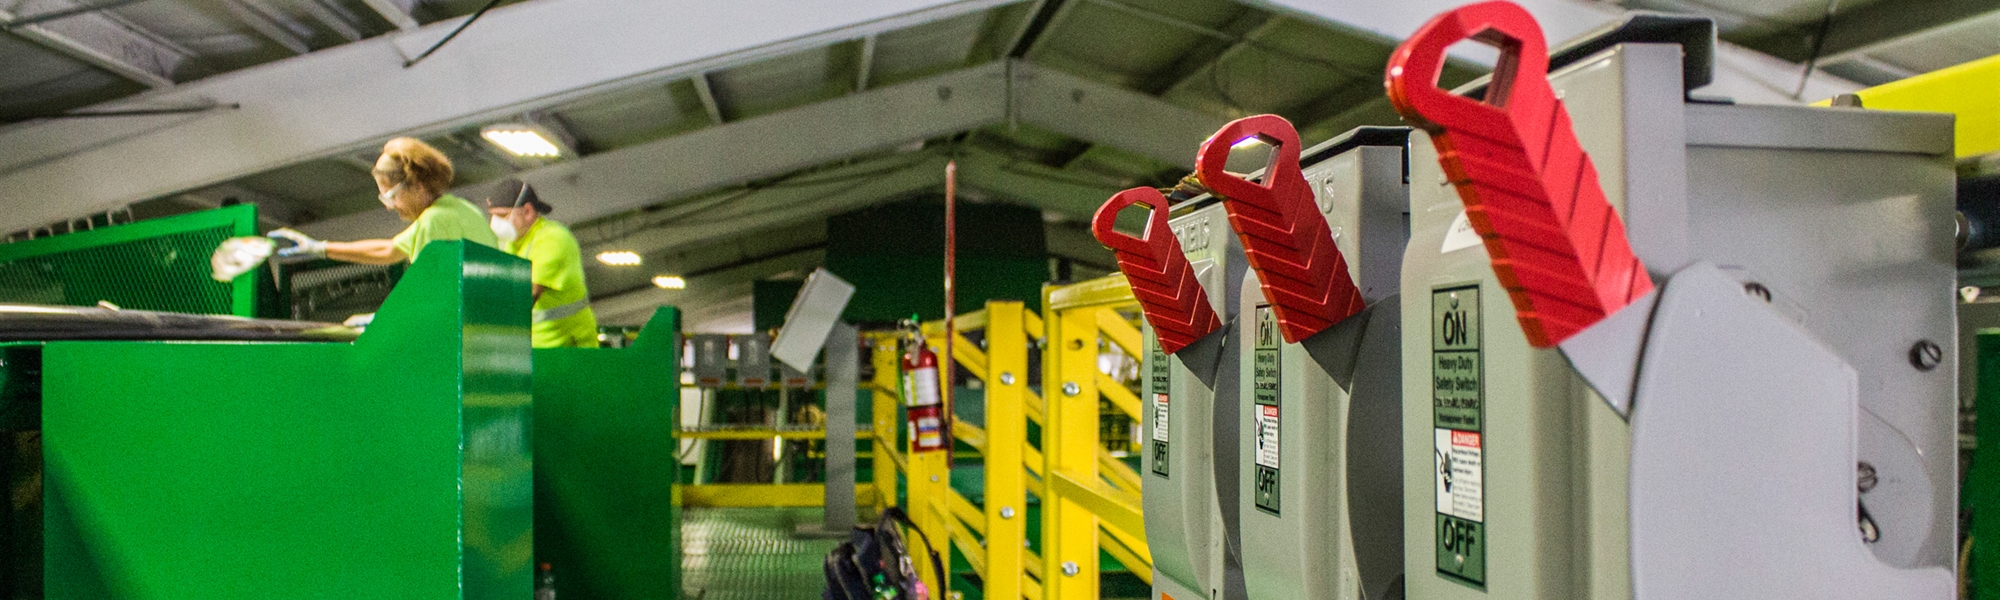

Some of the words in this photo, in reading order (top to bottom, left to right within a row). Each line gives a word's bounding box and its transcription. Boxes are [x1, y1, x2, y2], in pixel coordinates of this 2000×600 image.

[1260, 320, 1273, 346] ON
[1443, 310, 1467, 346] ON
[1438, 355, 1457, 374] Heavy
[1458, 355, 1473, 374] Duty
[1436, 376, 1454, 394] Safety
[1456, 376, 1477, 392] Switch
[1155, 442, 1166, 462] OFF
[1259, 466, 1275, 494] OFF
[1443, 518, 1475, 556] OFF
